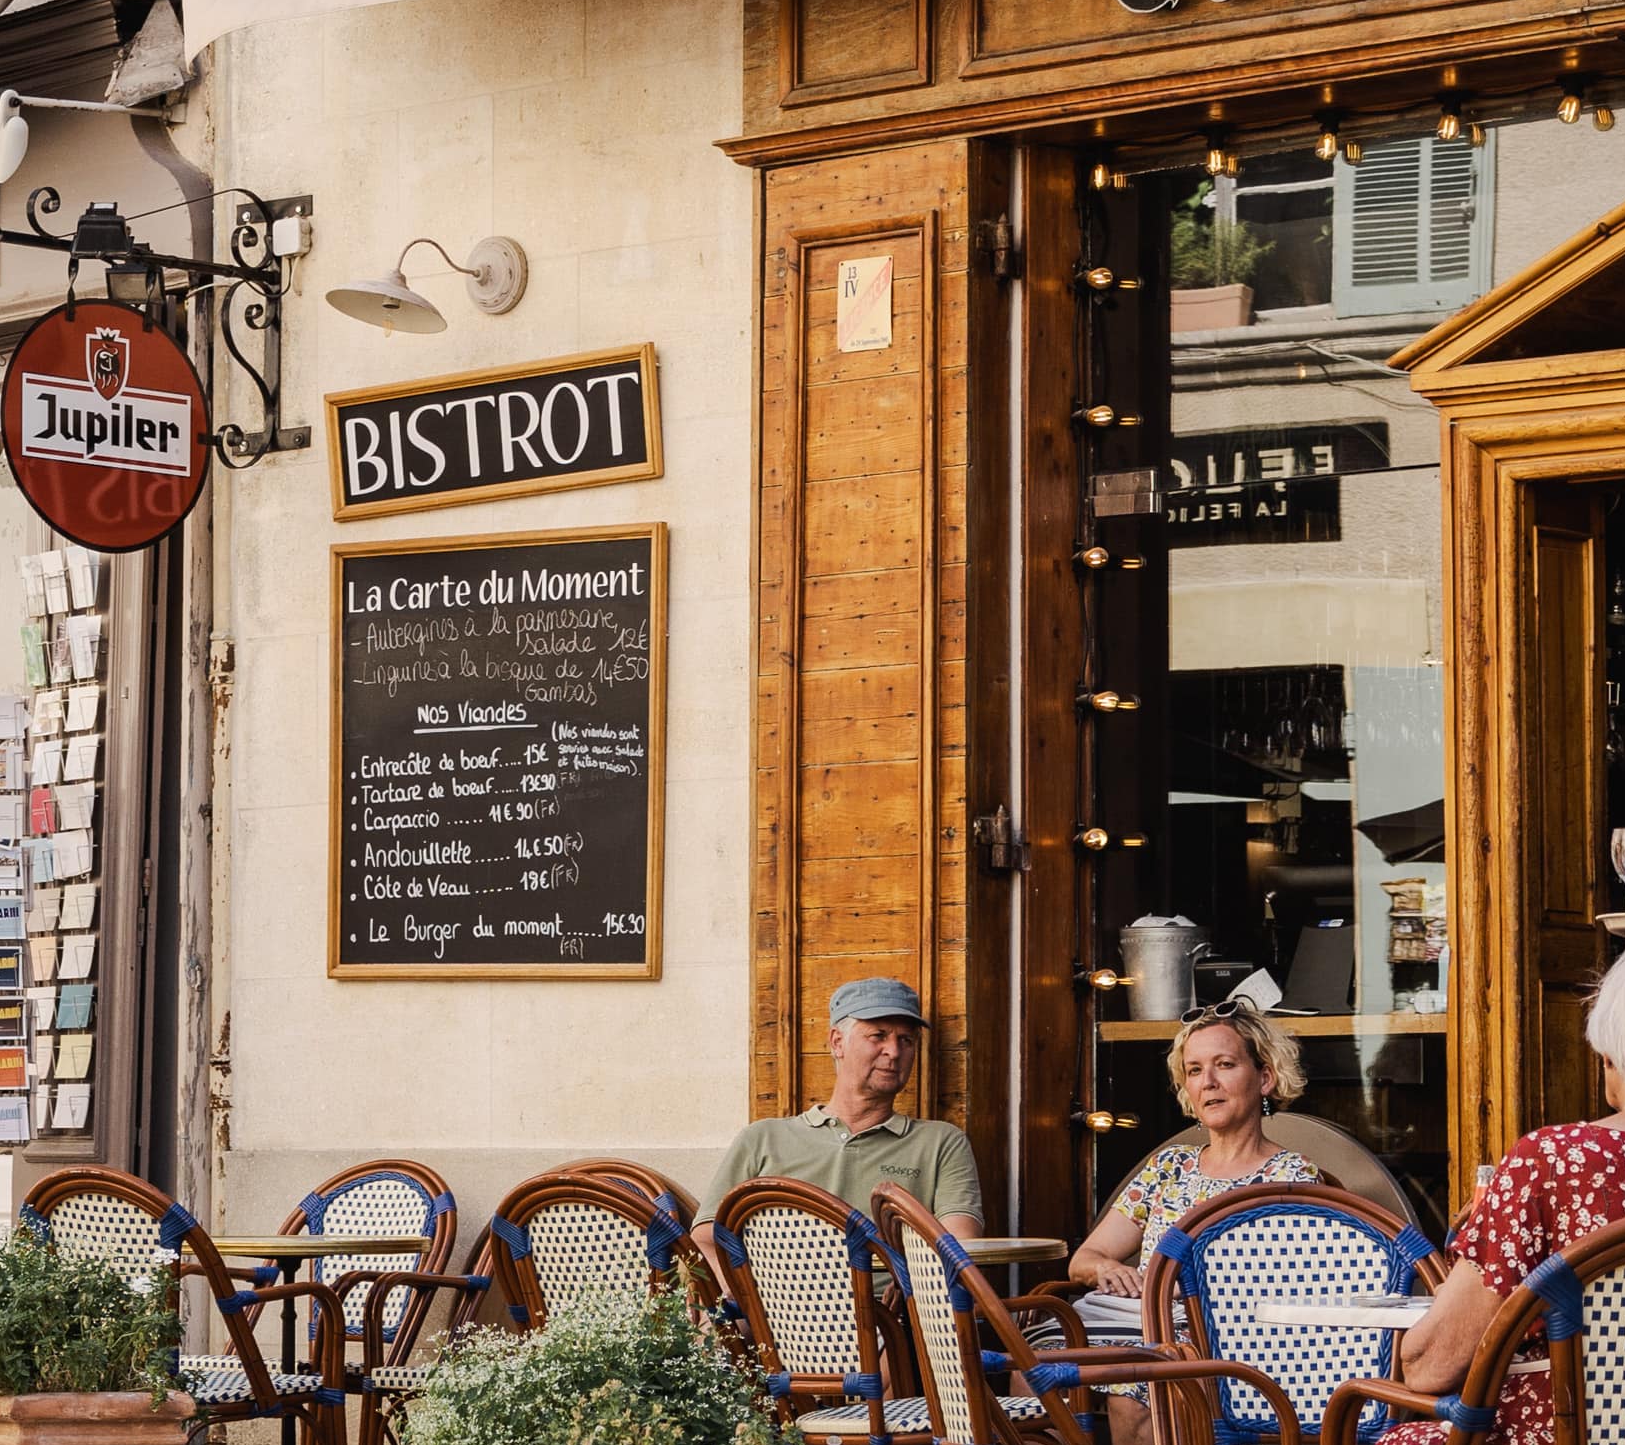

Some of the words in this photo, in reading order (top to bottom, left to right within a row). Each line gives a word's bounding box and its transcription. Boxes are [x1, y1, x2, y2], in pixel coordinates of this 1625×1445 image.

[34, 392, 180, 455] Jupiler
[344, 371, 639, 497] BISTROT
[348, 581, 382, 613] La
[389, 575, 471, 611] Carte
[479, 570, 514, 605] du
[521, 562, 646, 602] Moment
[487, 606, 510, 635] la
[519, 631, 596, 656] salade
[459, 649, 479, 678] la
[555, 659, 583, 679] de
[457, 699, 527, 724] Viandes
[619, 724, 640, 740] sont
[361, 752, 432, 780] Entrecôte
[439, 753, 455, 771] de
[523, 742, 549, 766] 15€
[361, 781, 423, 805] Tartare
[428, 778, 445, 798] de
[364, 807, 440, 836] Carpaccio
[364, 839, 472, 868] Andouillette
[407, 880, 423, 898] de
[427, 874, 470, 896] Veau
[369, 917, 391, 943] Le
[404, 914, 461, 959] Burger
[472, 914, 494, 938] du
[504, 912, 563, 936] moment
